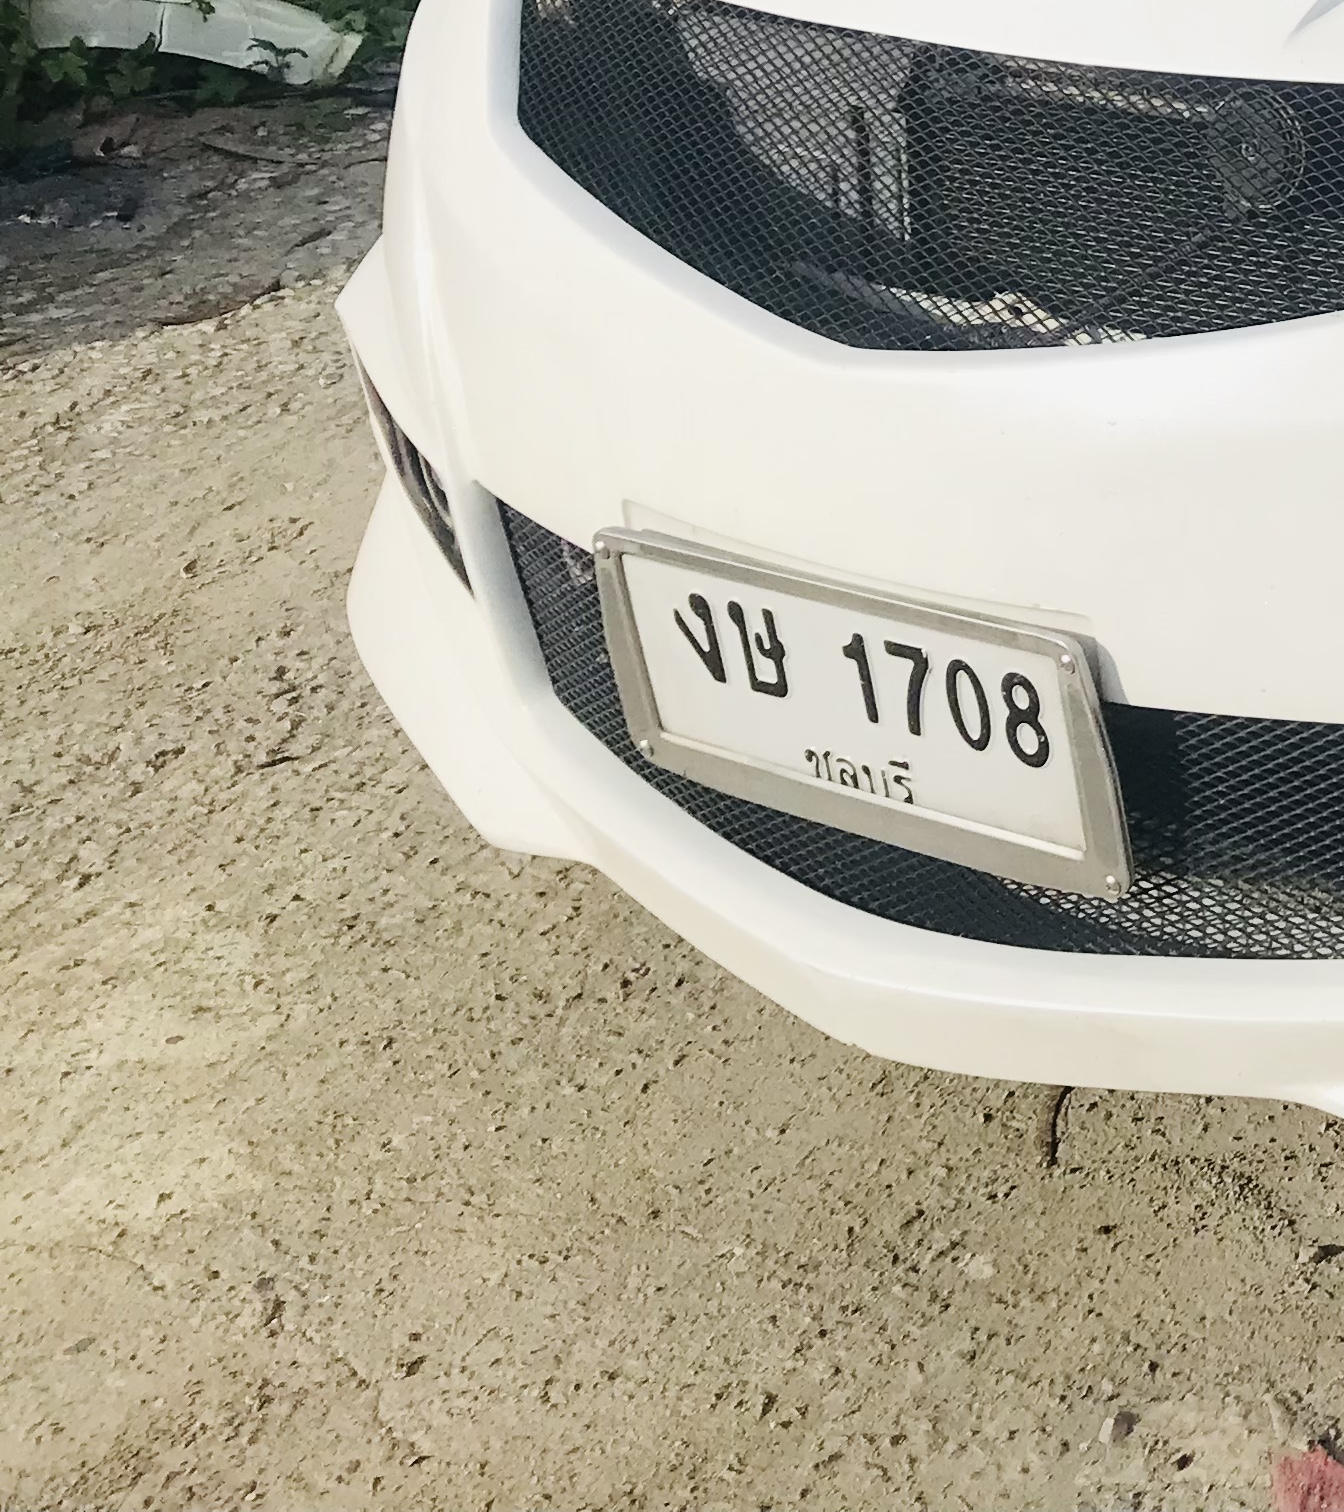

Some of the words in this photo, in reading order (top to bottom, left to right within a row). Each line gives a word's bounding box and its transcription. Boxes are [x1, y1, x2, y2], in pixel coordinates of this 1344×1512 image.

[674, 593, 788, 698] งษ
[842, 633, 1050, 768] 1708
[804, 748, 914, 805] ชลบรี
